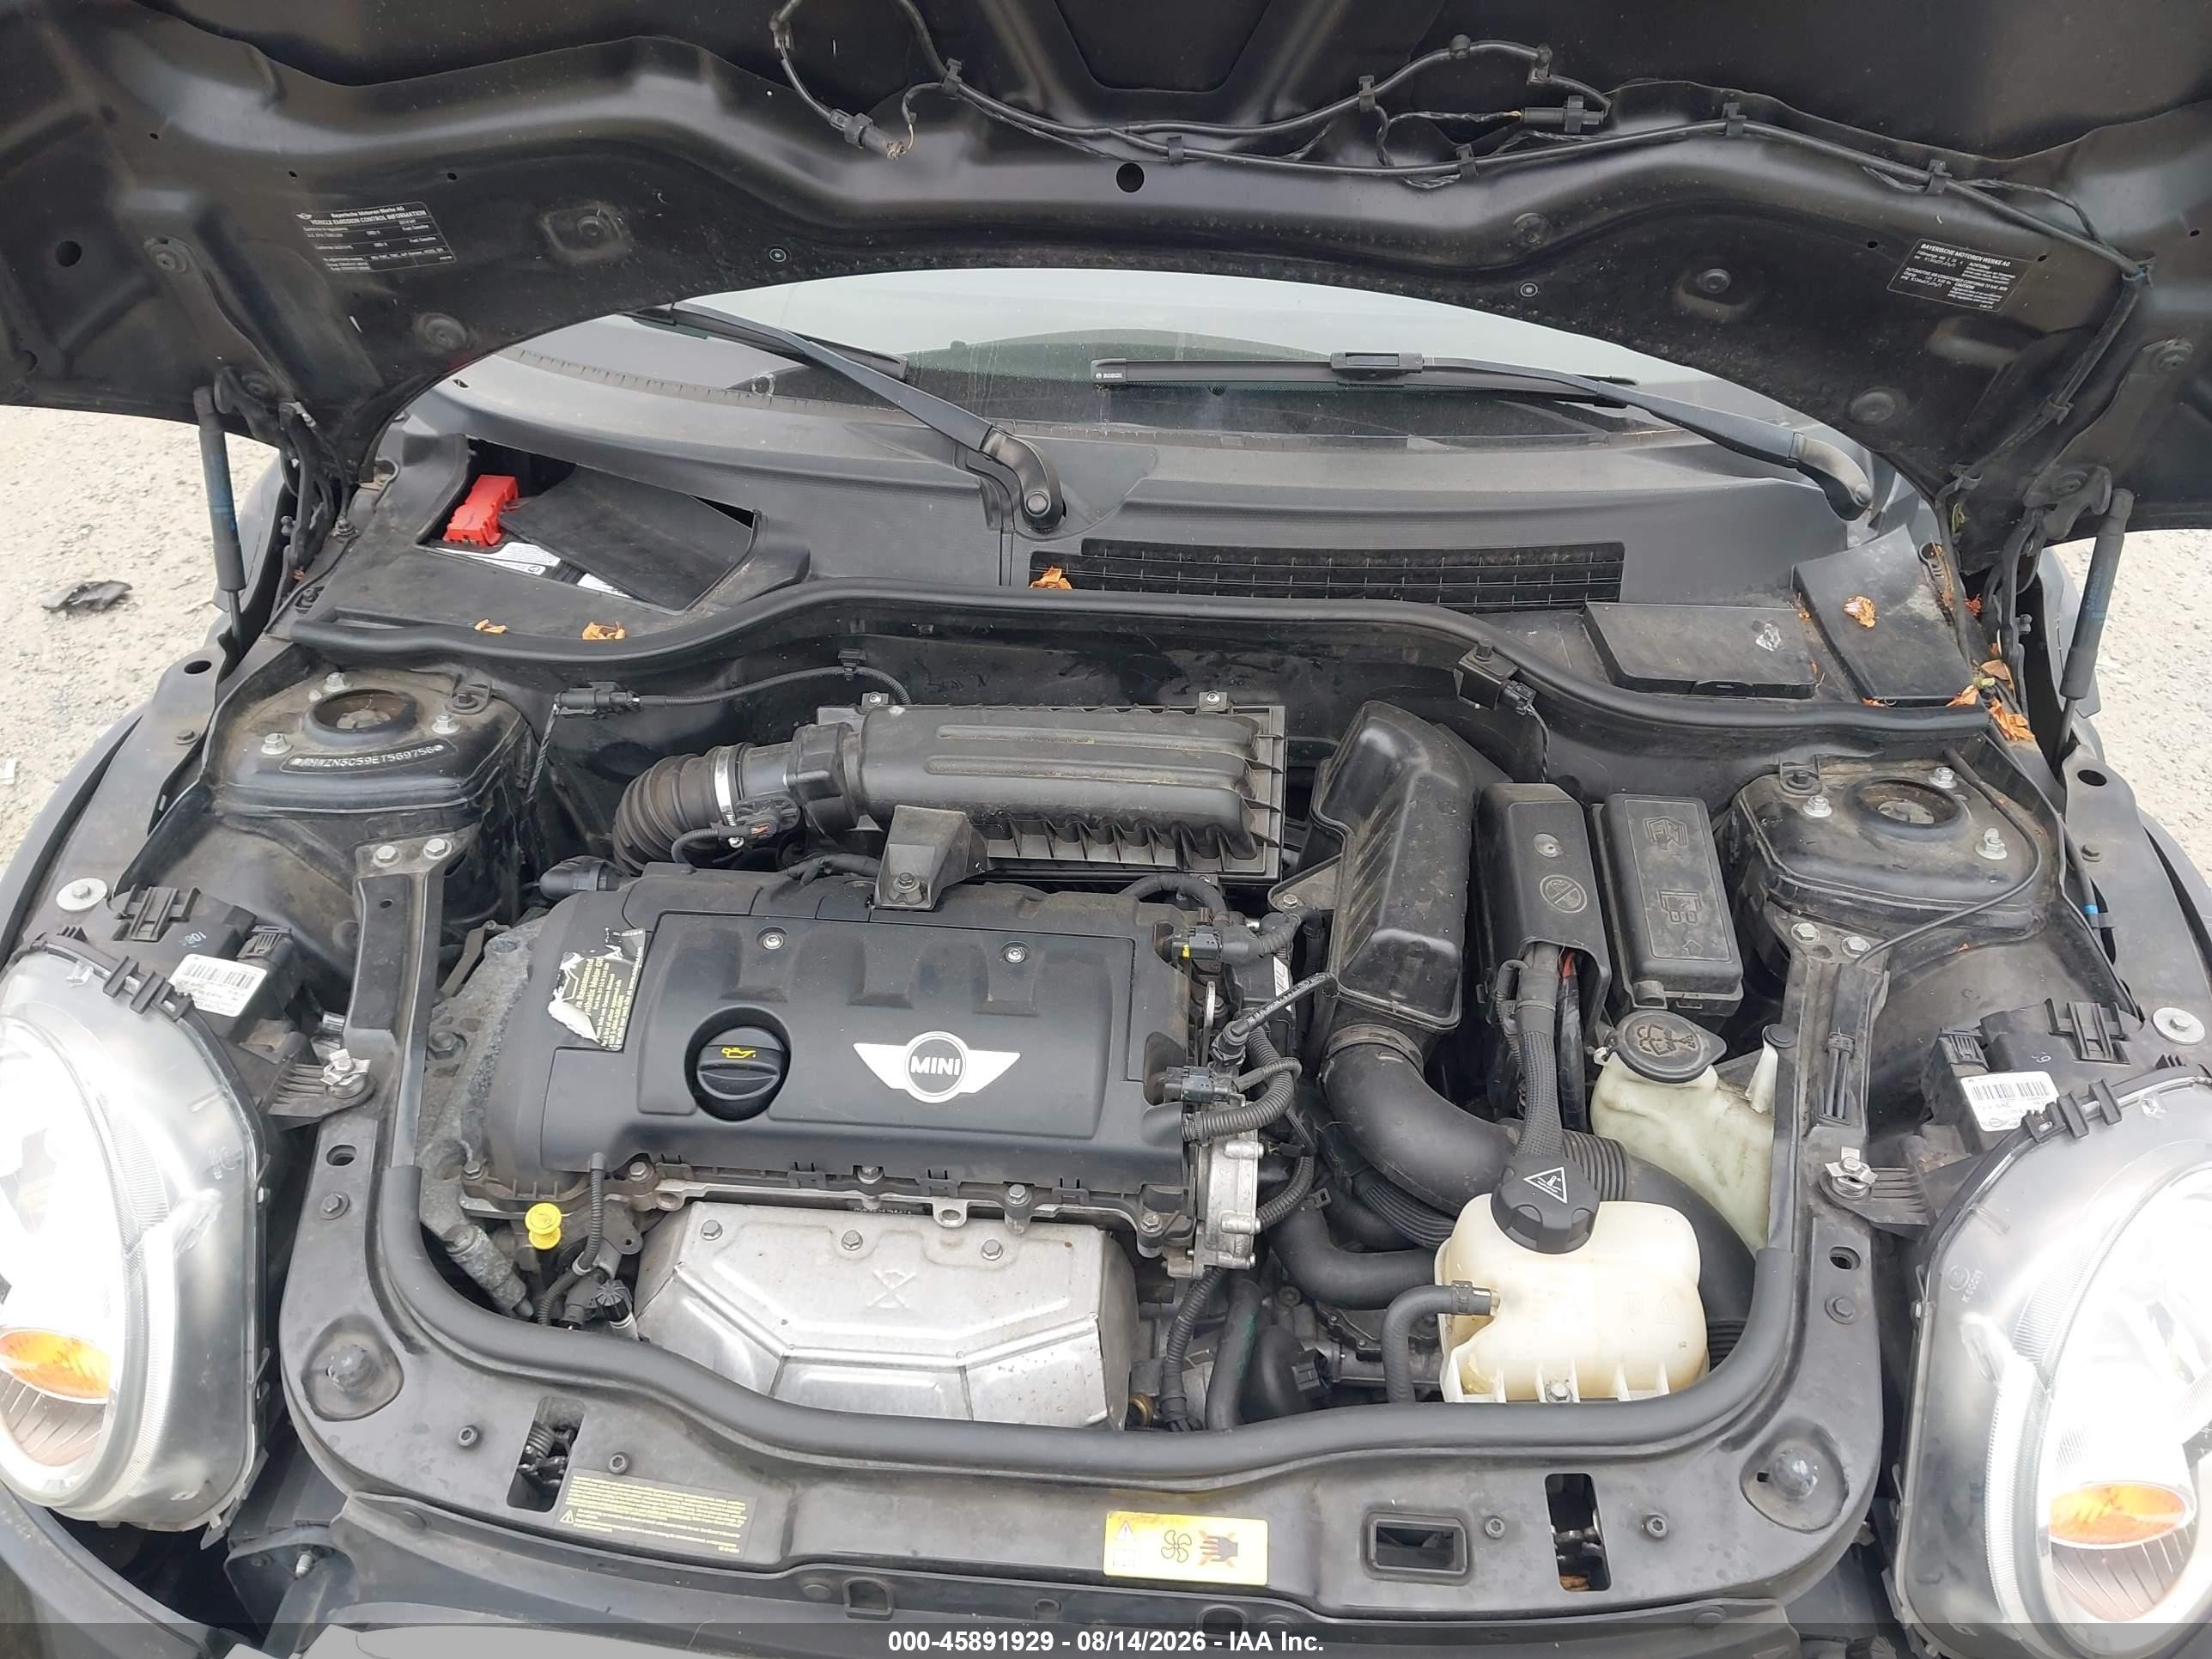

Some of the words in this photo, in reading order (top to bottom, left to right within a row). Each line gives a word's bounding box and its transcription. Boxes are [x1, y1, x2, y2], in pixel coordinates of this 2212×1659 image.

[1920, 243, 1956, 256] BAYERISCHE
[1955, 251, 1984, 261] MOTOREN
[590, 969, 602, 988] Motor
[910, 1055, 961, 1076] MINI
